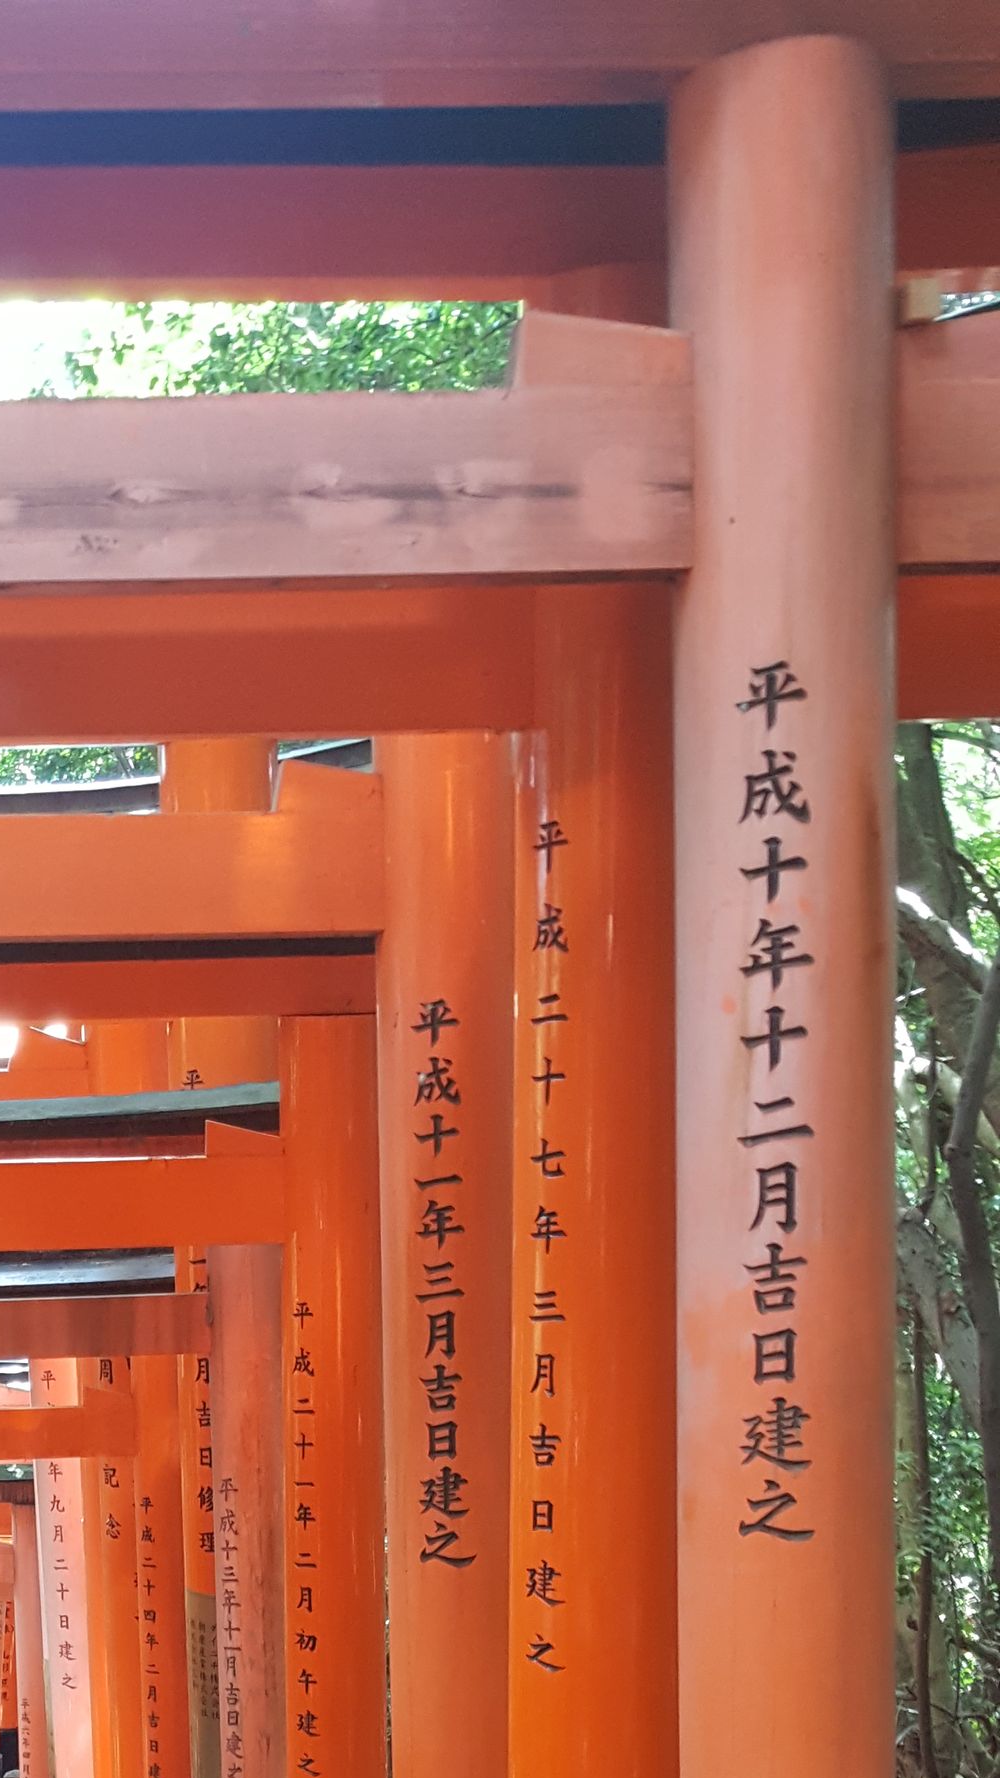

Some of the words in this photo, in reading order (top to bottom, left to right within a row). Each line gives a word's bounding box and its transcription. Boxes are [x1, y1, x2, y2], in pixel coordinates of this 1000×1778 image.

[411, 999, 477, 1568] 平成十一年三月吉日建之
[526, 820, 570, 1673] 平成二十七年三月吉日建之
[734, 662, 815, 1541] 平成十年十二月吉日建之
[47, 1461, 77, 1690] 年九月二十日建之
